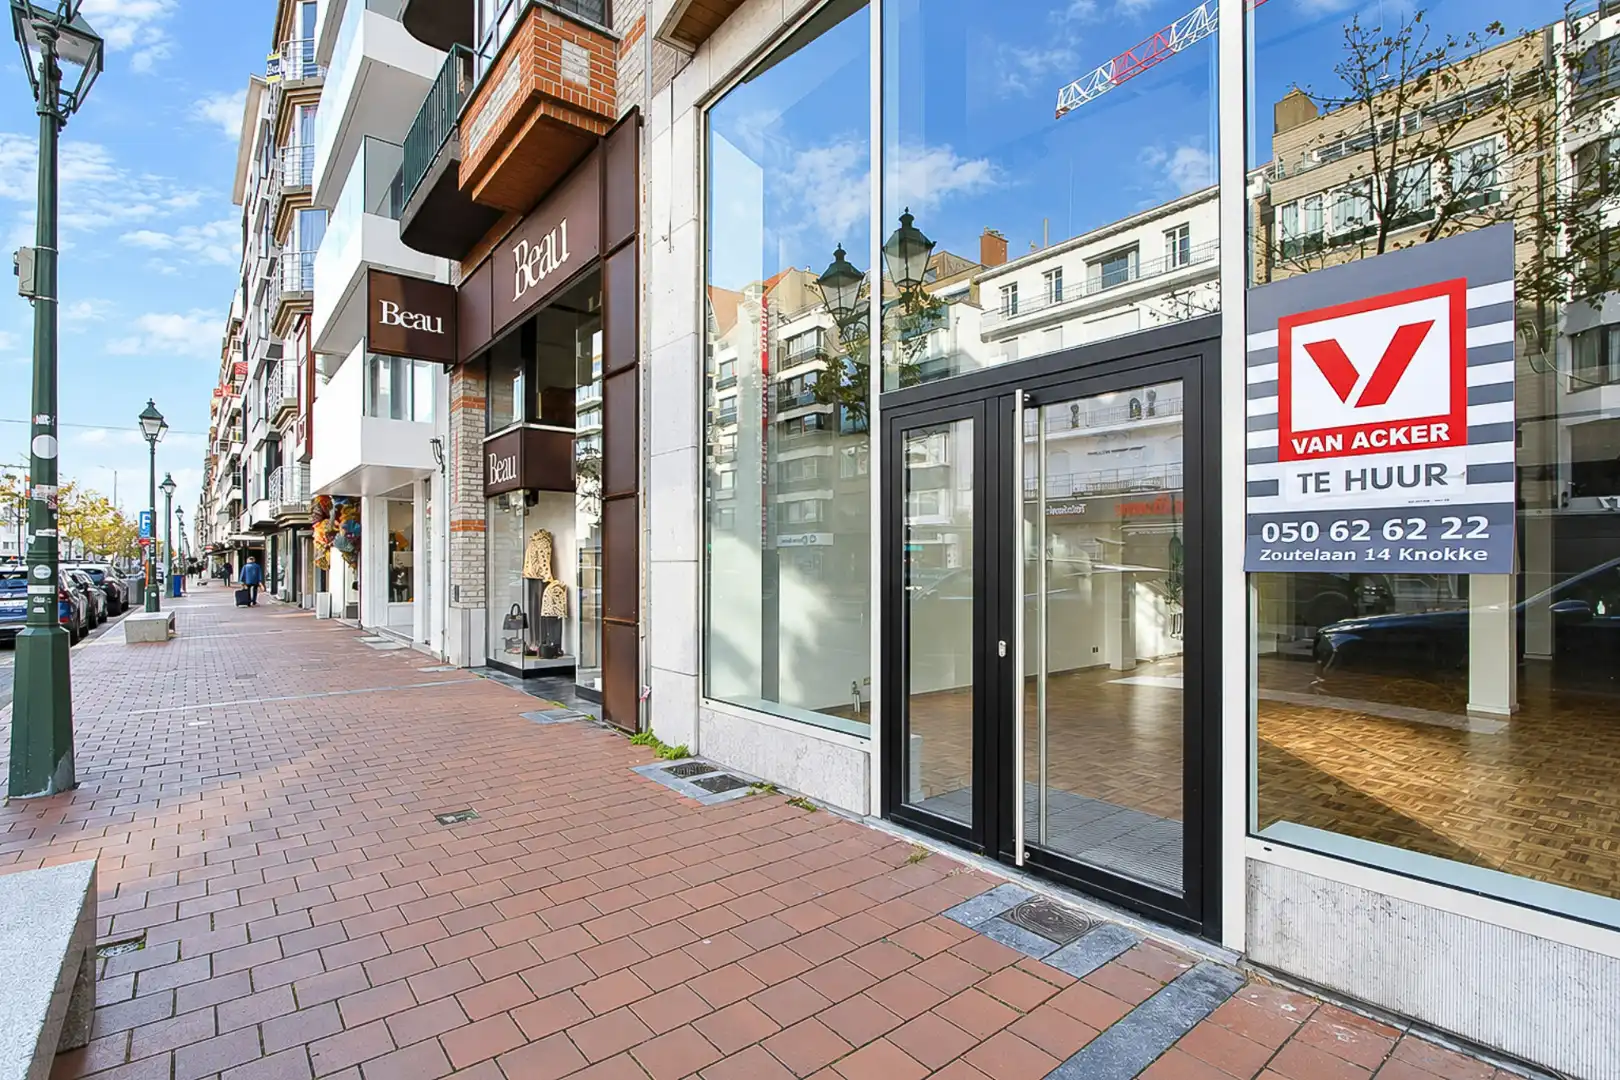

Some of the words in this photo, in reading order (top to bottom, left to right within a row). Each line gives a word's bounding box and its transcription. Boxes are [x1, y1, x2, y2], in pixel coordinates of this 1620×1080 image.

[513, 216, 571, 302] Beau
[378, 299, 444, 334] Beau
[1291, 433, 1343, 455] VAN
[1351, 422, 1450, 449] ACKER
[488, 452, 517, 486] Beau
[1297, 471, 1331, 494] TE
[1344, 462, 1449, 492] HUUR
[1261, 521, 1320, 543] 050
[1329, 519, 1371, 542] 62
[1381, 517, 1428, 541] 62
[1440, 515, 1490, 540] 22
[1259, 547, 1356, 562] Zoutelaan
[1364, 547, 1391, 561] 14
[1398, 546, 1489, 562] Knokke
